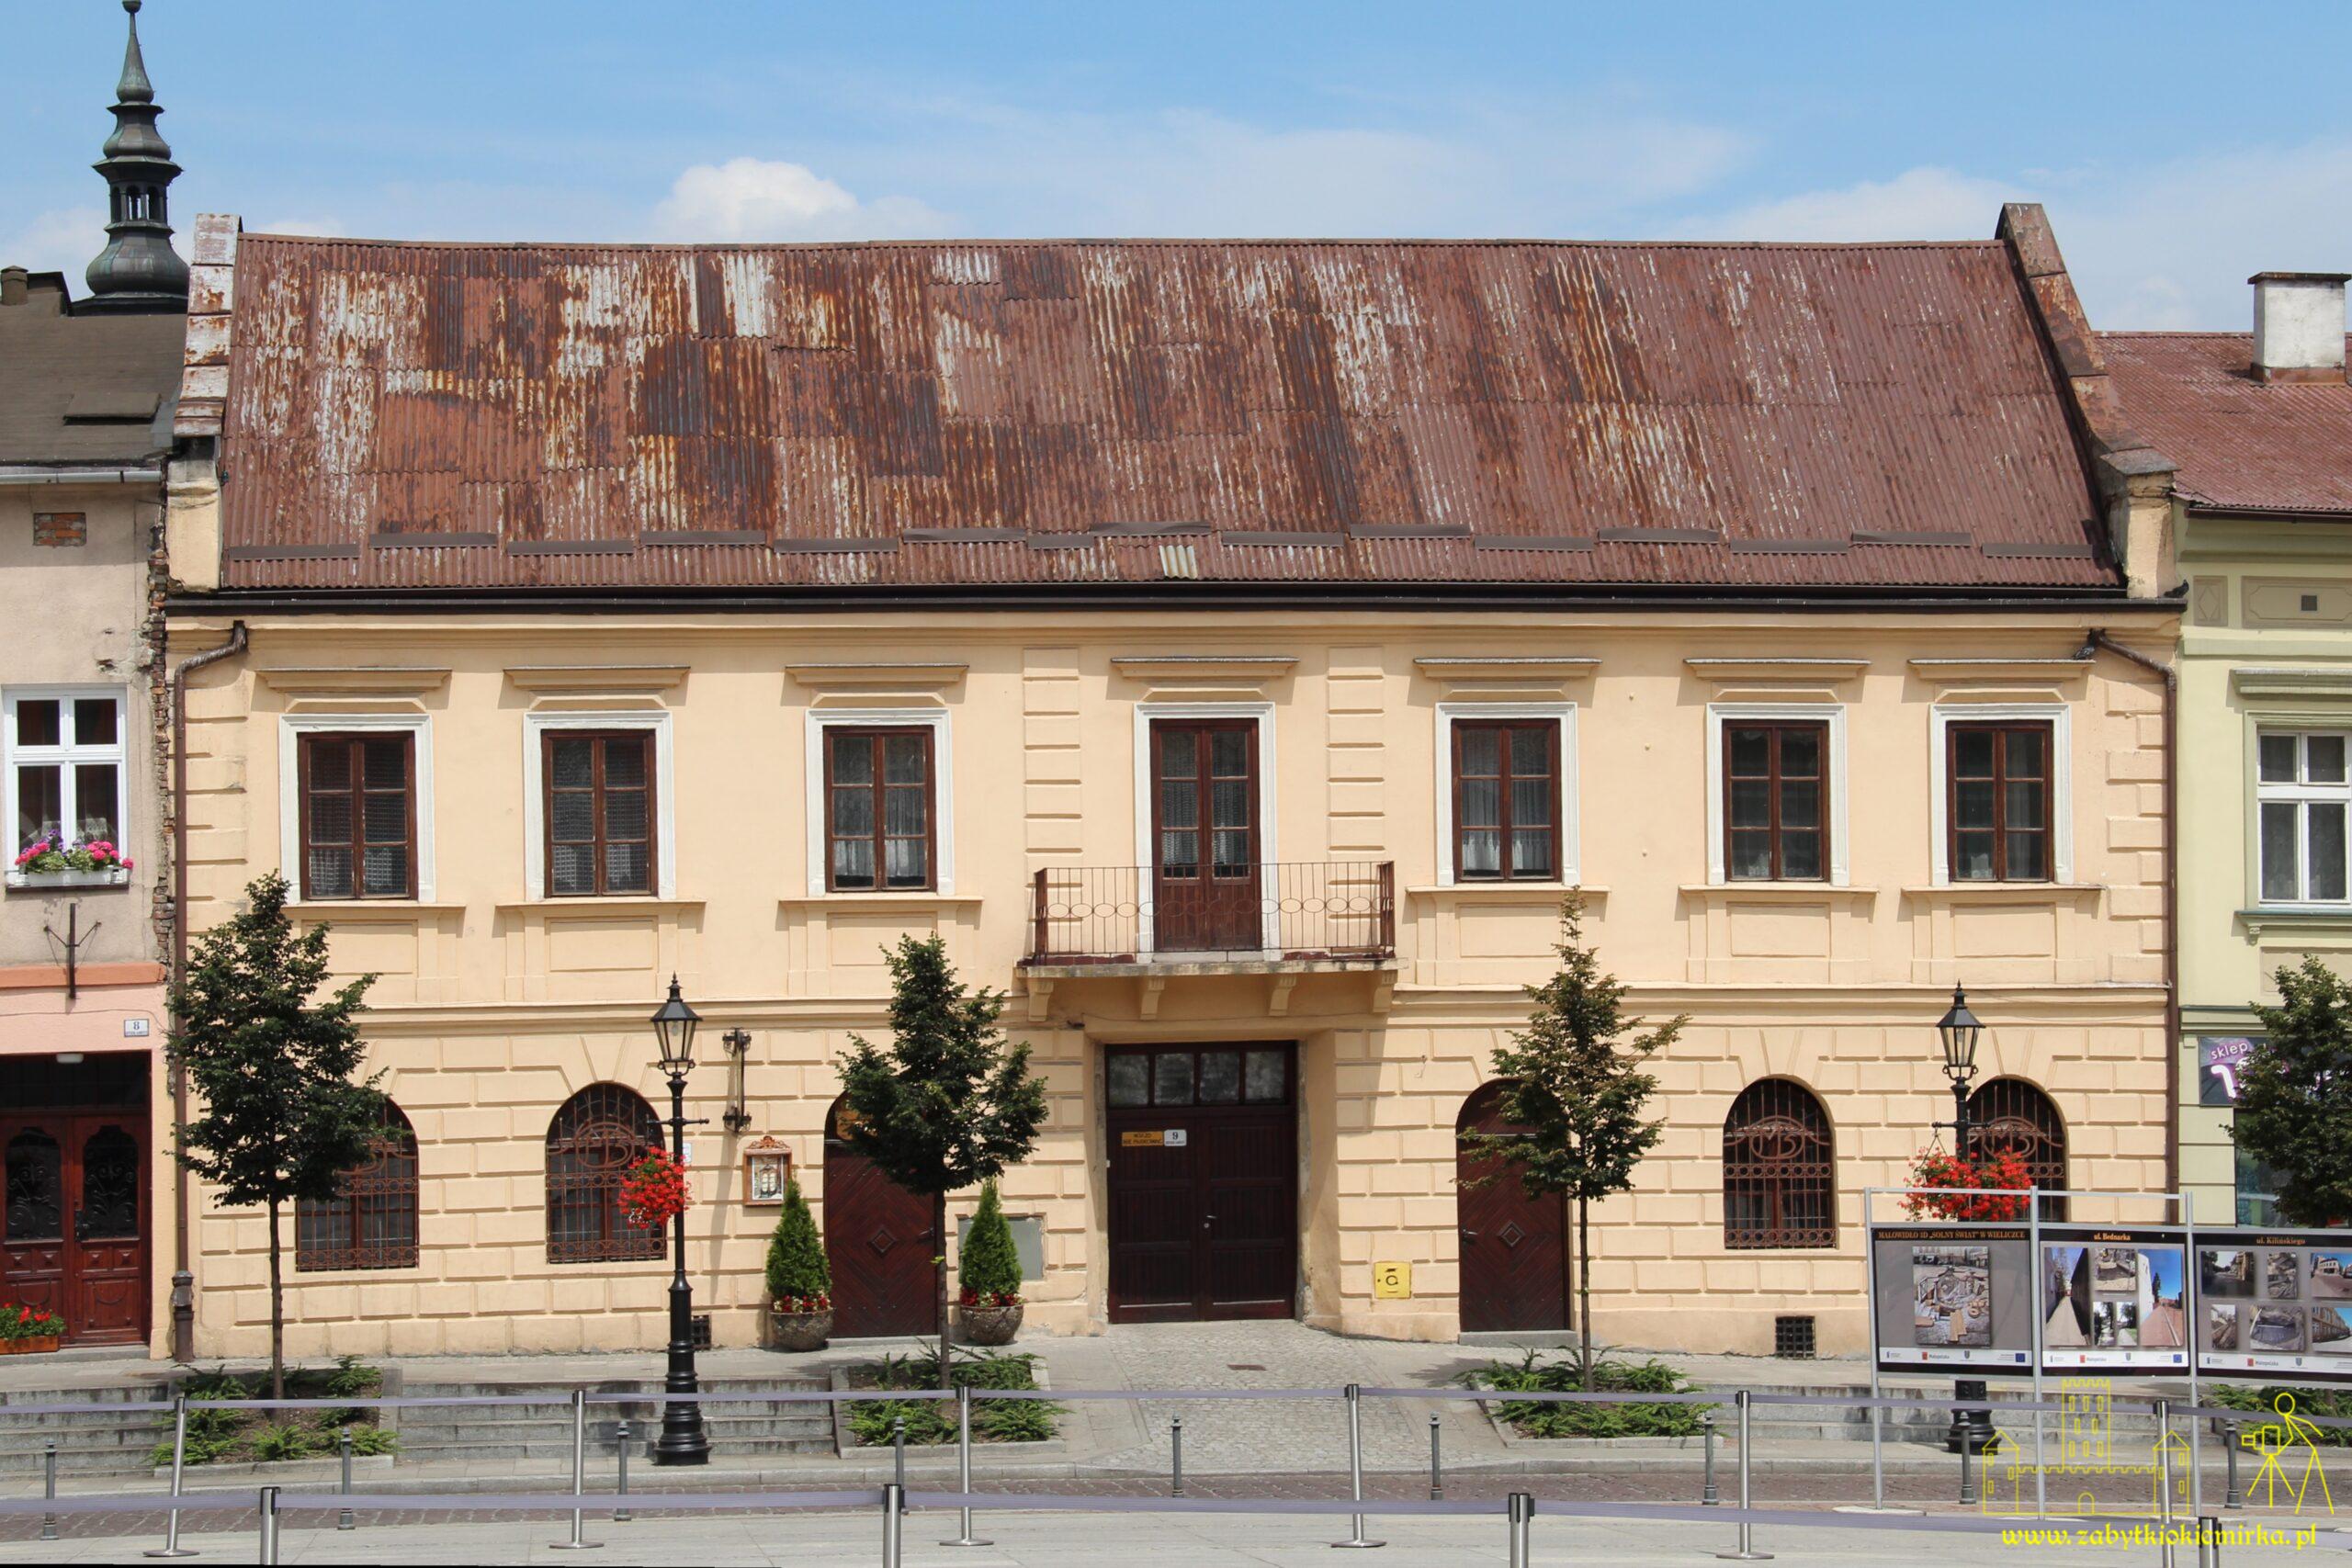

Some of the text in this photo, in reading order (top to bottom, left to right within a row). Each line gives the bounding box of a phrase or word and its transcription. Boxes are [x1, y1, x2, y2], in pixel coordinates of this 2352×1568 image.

[133, 1021, 140, 1030] 8
[2211, 1043, 2248, 1059] sklep
[1172, 1131, 1178, 1140] 9
